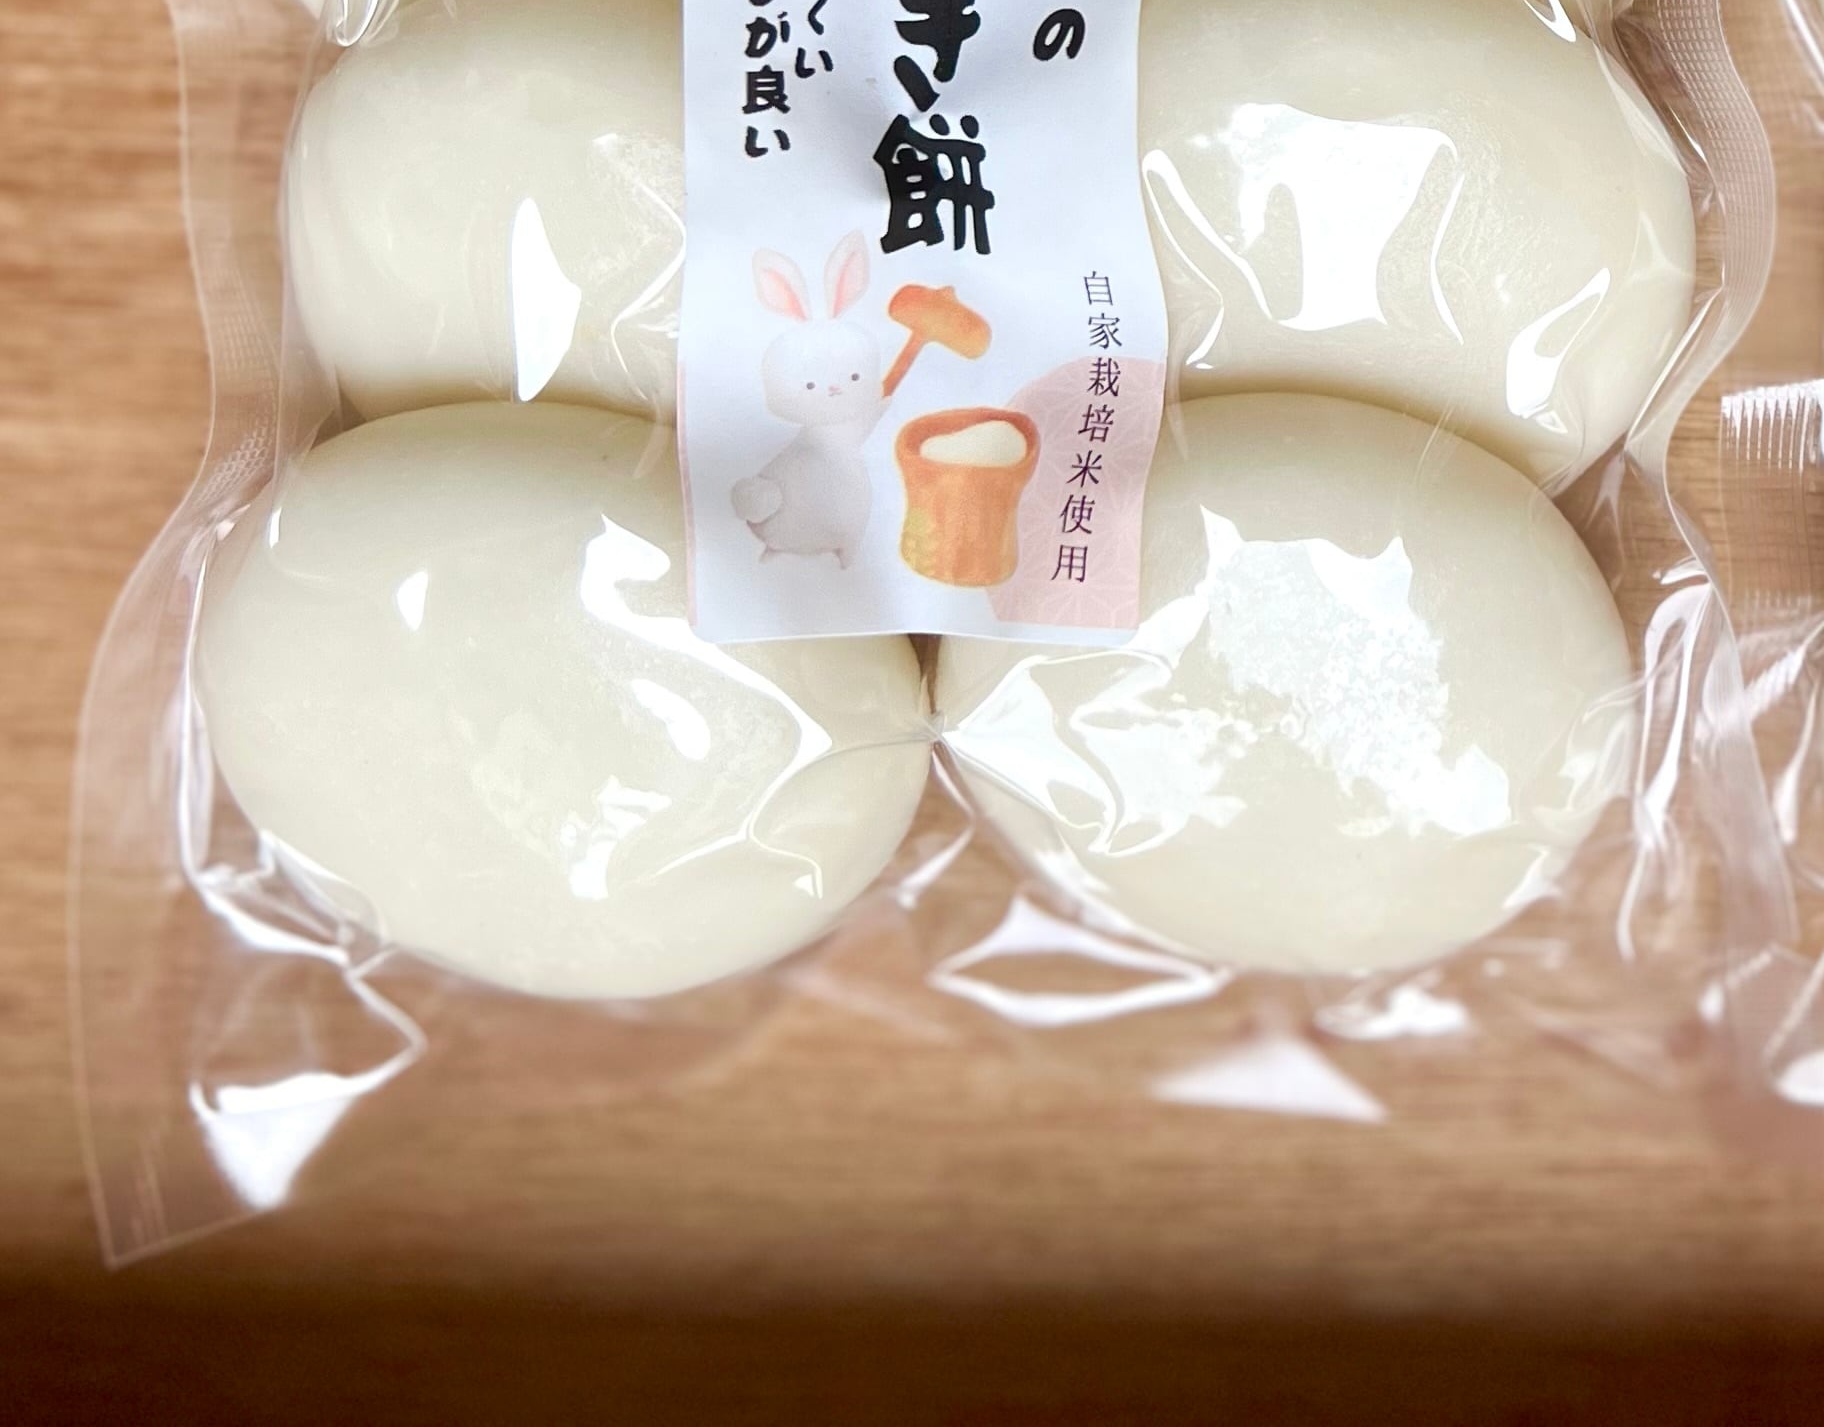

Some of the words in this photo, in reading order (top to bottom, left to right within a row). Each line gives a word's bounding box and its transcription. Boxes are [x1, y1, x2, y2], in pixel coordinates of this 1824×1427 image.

[1050, 271, 1124, 583] 自家栽培米使用
